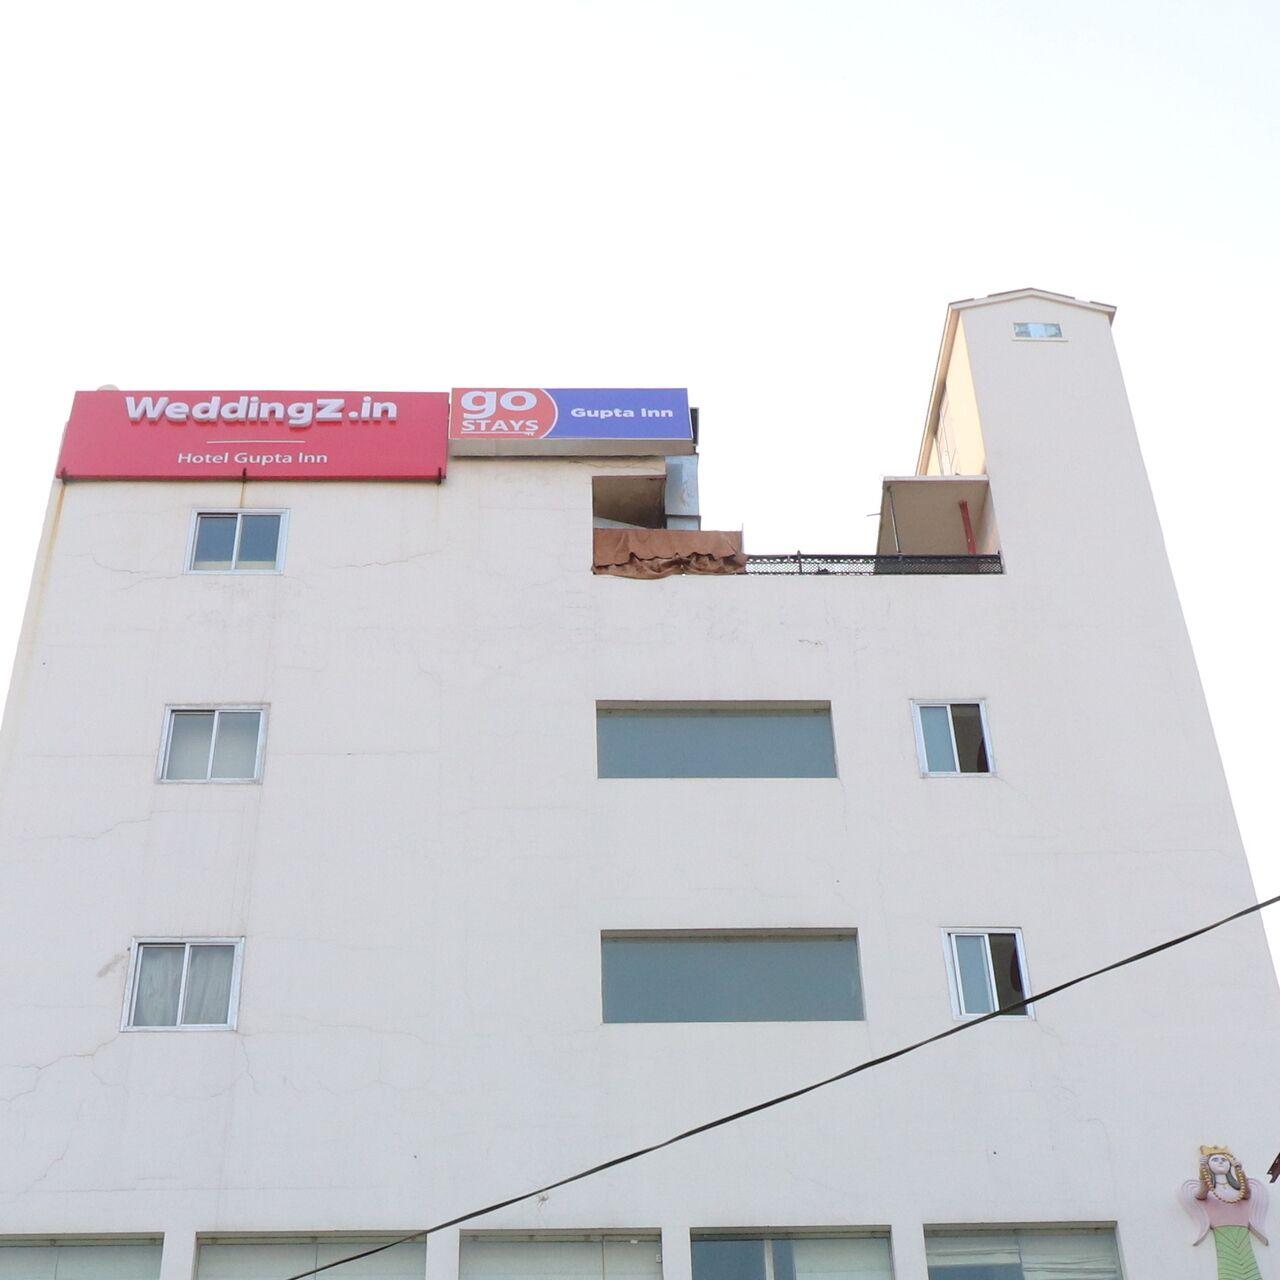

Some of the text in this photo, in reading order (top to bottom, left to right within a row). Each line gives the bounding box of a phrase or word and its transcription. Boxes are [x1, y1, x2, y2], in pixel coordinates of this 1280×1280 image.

[460, 390, 538, 419] go
[571, 407, 674, 419] Gupta Inn
[460, 419, 539, 431] STAYS
[177, 452, 328, 466] Hotel Gupta Inn
